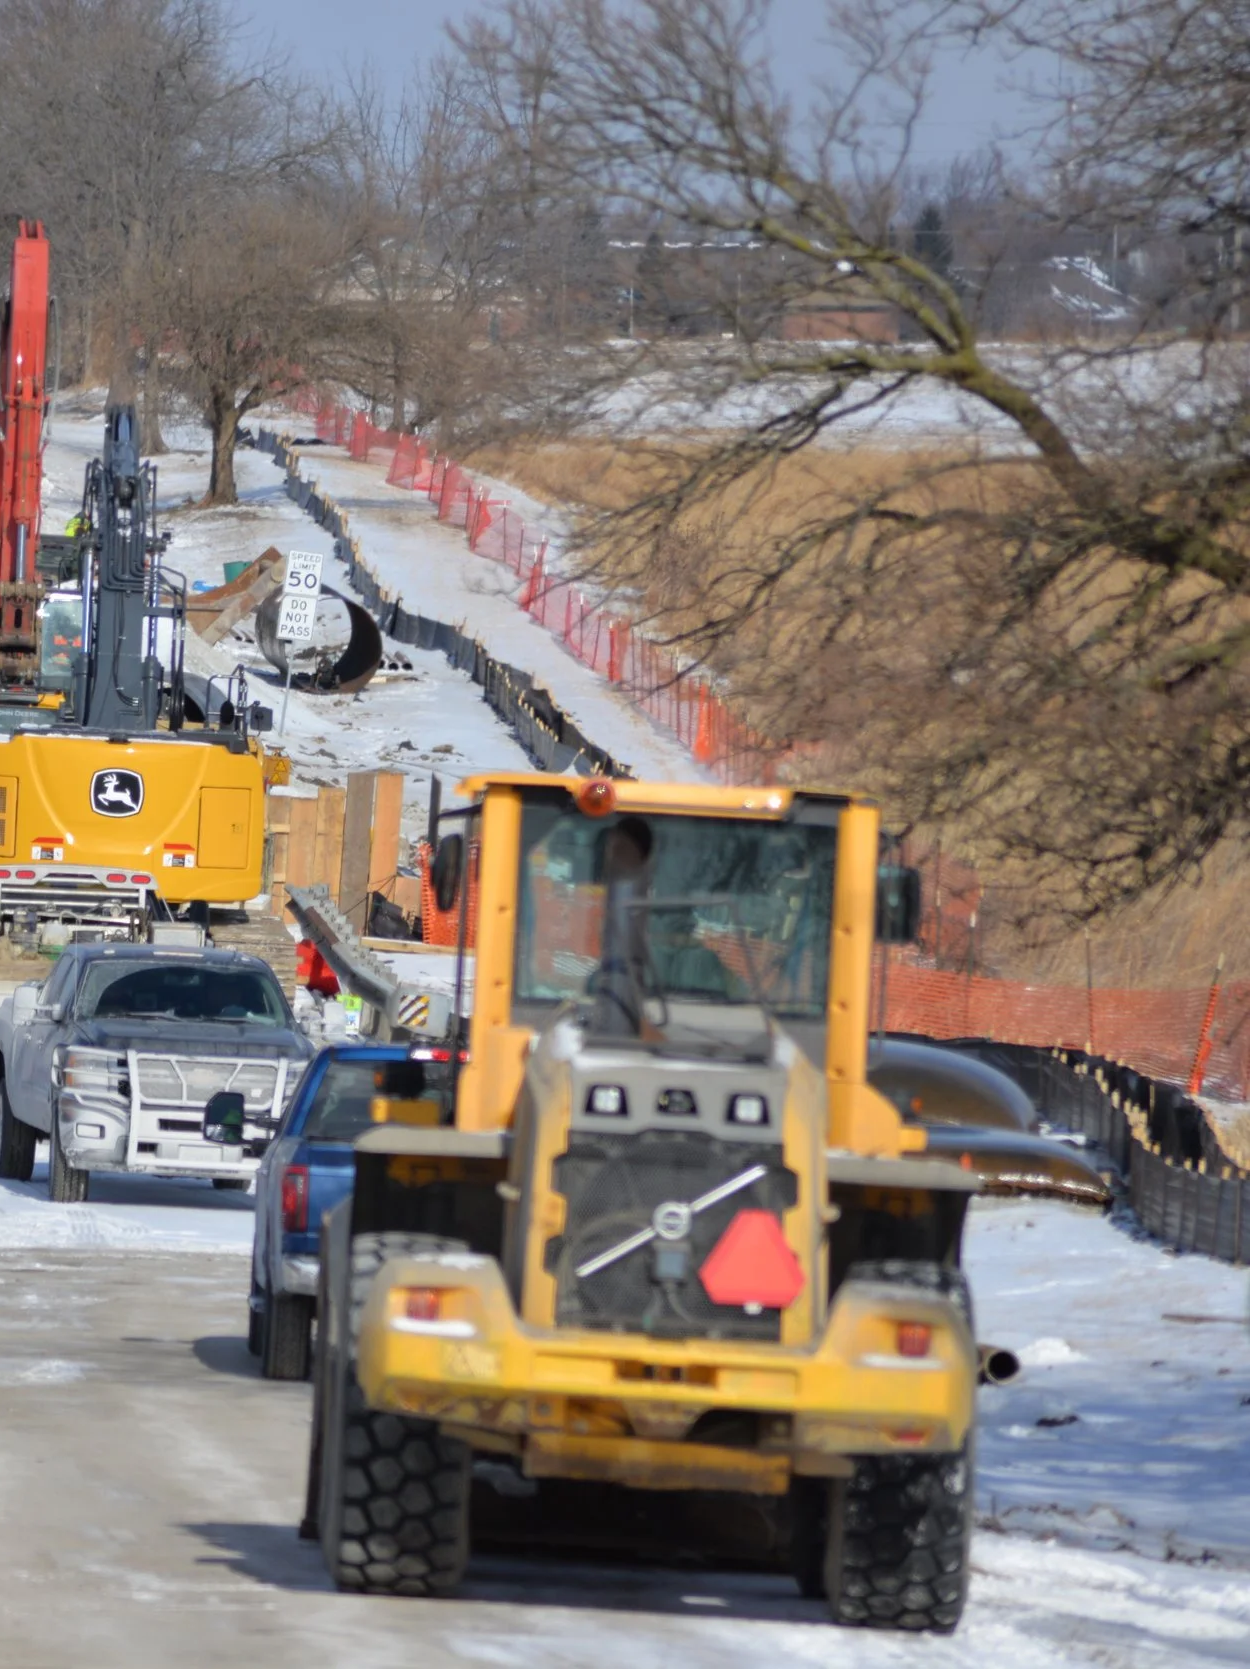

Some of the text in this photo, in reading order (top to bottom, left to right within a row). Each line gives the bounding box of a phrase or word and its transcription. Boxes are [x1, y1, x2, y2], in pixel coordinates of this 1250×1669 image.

[291, 553, 321, 563] SPEED
[293, 563, 316, 571] LIMIT
[288, 571, 317, 589] 50
[291, 599, 307, 611] DO
[286, 612, 309, 623] NOT
[280, 624, 310, 637] PASS
